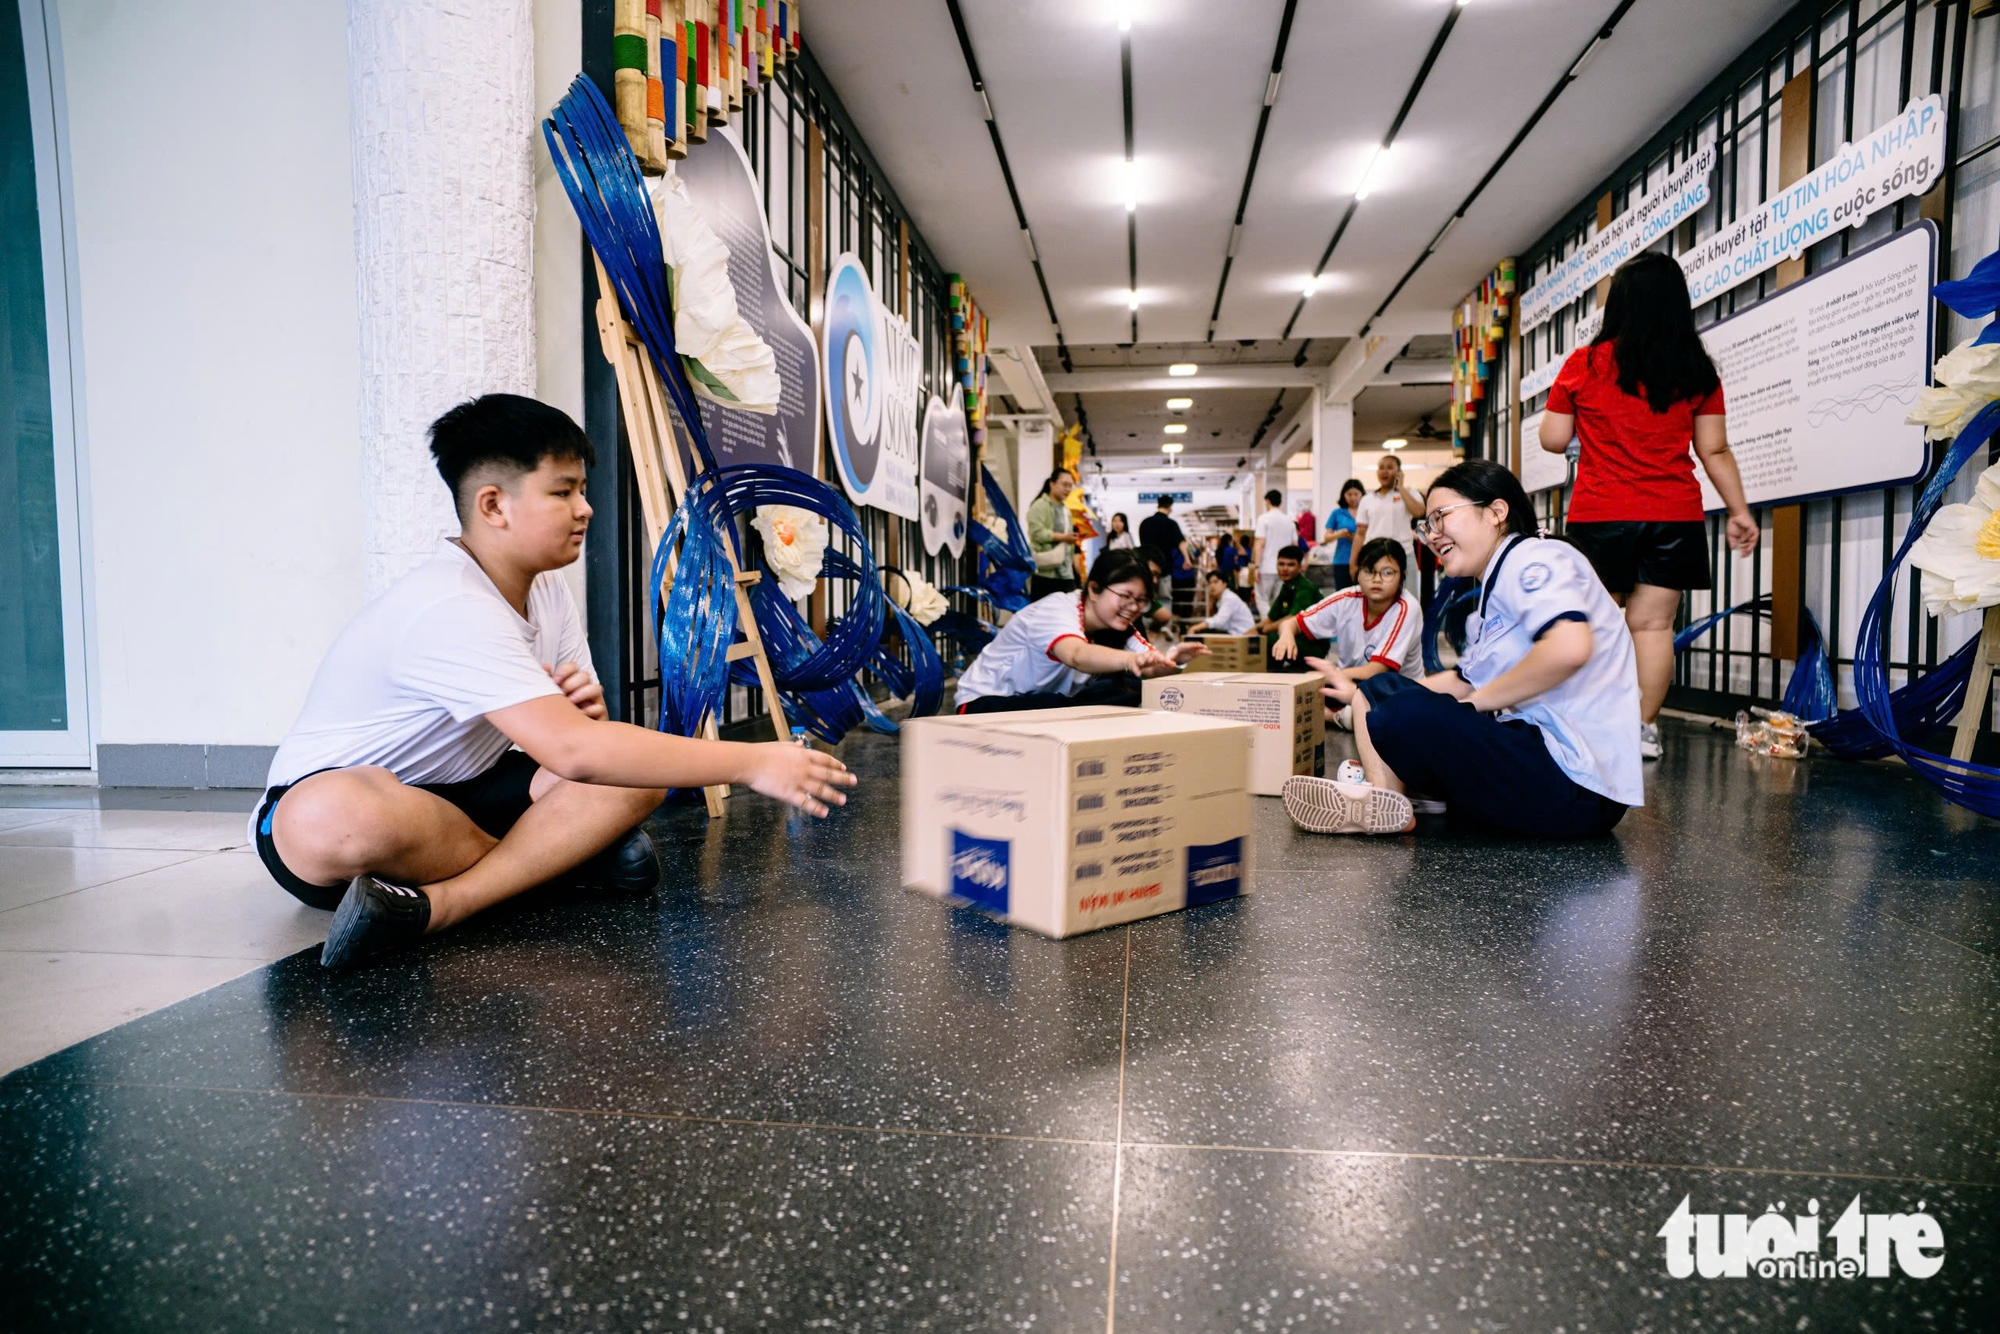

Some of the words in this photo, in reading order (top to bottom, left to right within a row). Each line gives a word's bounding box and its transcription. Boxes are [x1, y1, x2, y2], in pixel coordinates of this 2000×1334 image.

[1586, 243, 1599, 260] của
[1611, 219, 1624, 242] hội
[1626, 209, 1635, 229] về
[1637, 189, 1661, 222] người
[1663, 161, 1693, 202] khuyết
[1697, 150, 1711, 175] tật
[1600, 241, 1628, 270] TRỌNG
[1630, 233, 1641, 252] và
[1642, 209, 1671, 243] CÔNG
[1673, 183, 1706, 221] BẰNG.
[1684, 248, 1706, 280] gười
[1708, 222, 1746, 263] khuyết
[1750, 211, 1768, 240] tật
[1772, 193, 1791, 224] TỰ
[1794, 176, 1820, 210] TIN
[1825, 150, 1866, 193] HÒA
[1871, 105, 1937, 165] NHẬP,
[1704, 264, 1731, 294] CAO
[1734, 240, 1770, 277] CHẤT
[1773, 208, 1829, 255] LƯỢNG
[1833, 186, 1876, 222] cuộc
[1881, 156, 1935, 197] sống.
[1870, 320, 1891, 335] nguyện
[1892, 315, 1905, 326] viên
[1905, 309, 1920, 321] Vượt
